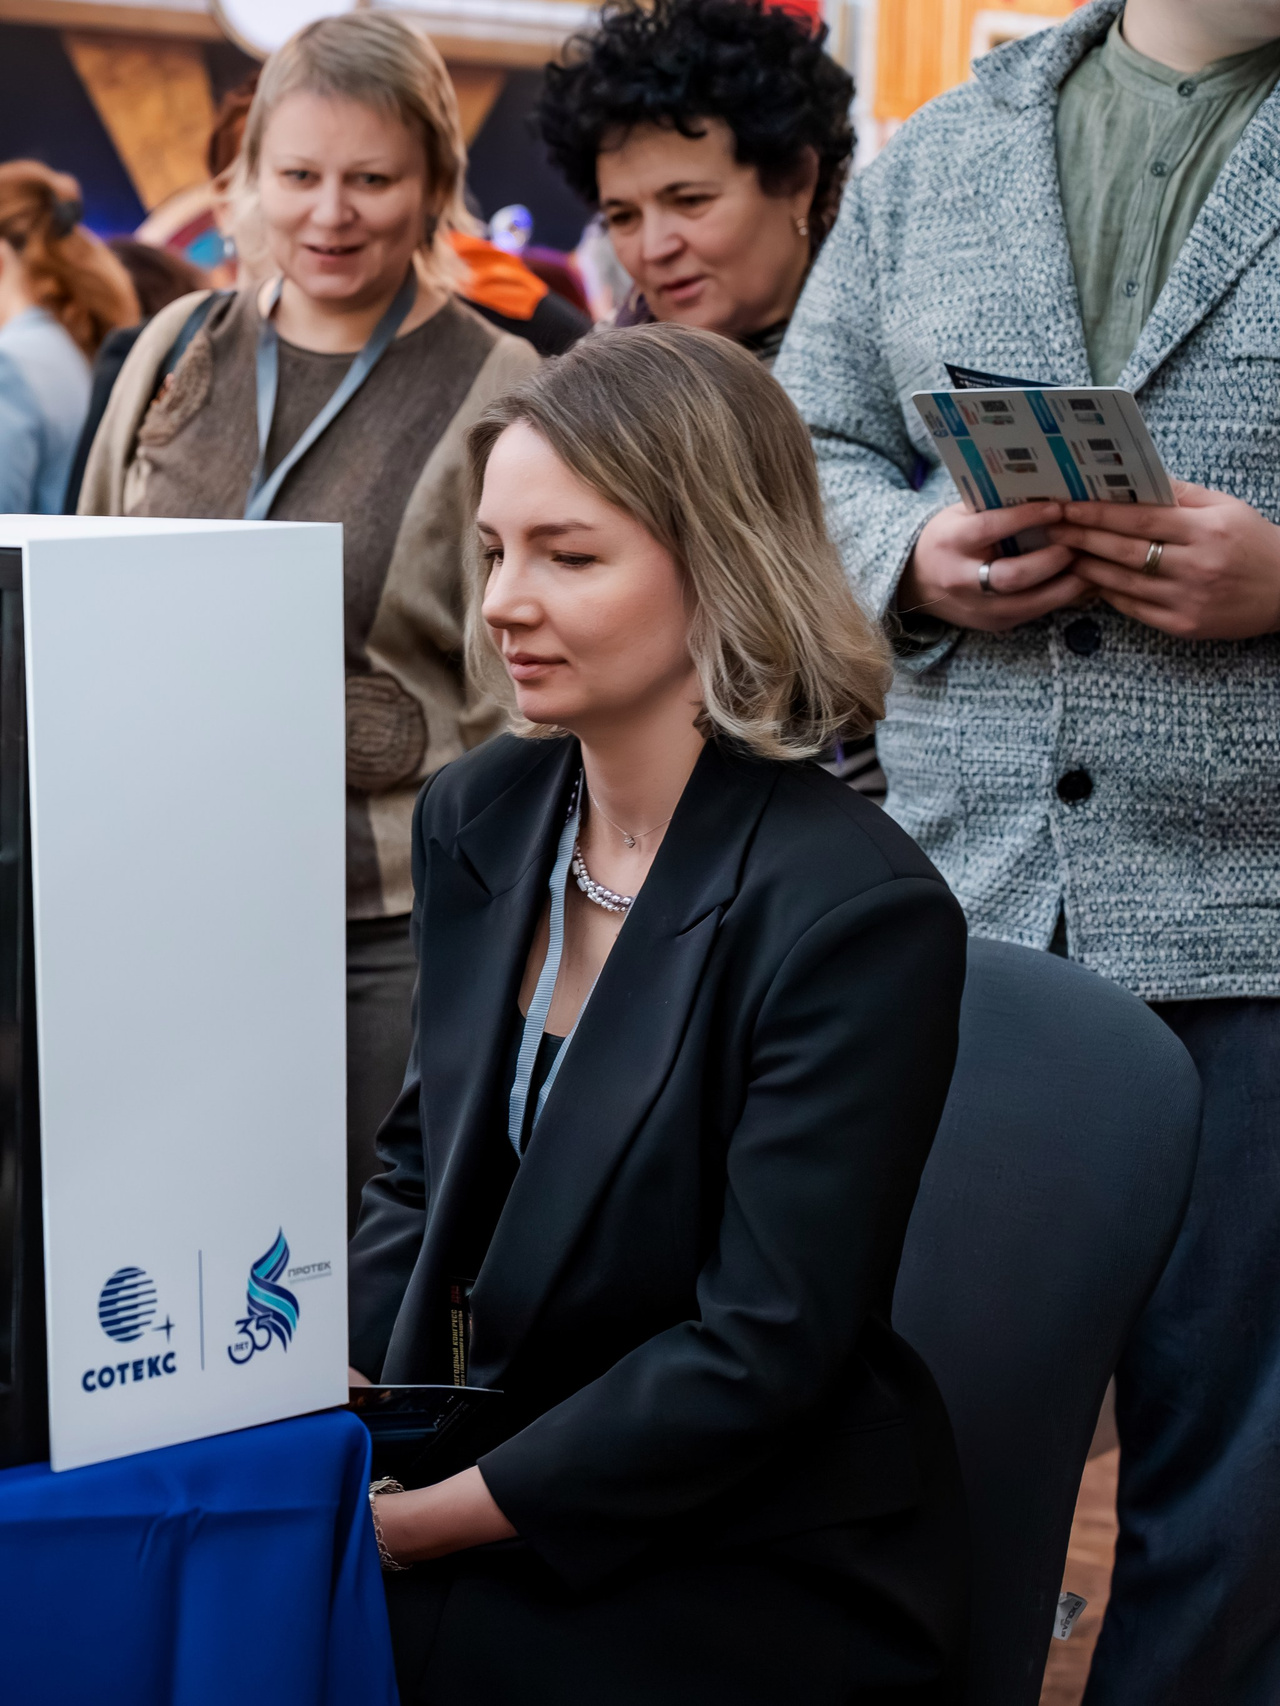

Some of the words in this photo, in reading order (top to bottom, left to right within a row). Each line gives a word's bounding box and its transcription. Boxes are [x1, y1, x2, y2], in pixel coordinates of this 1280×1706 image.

[287, 1261, 332, 1278] ПРОТЕК
[227, 1312, 272, 1365] 35
[82, 1352, 177, 1392] СОТЕКС
